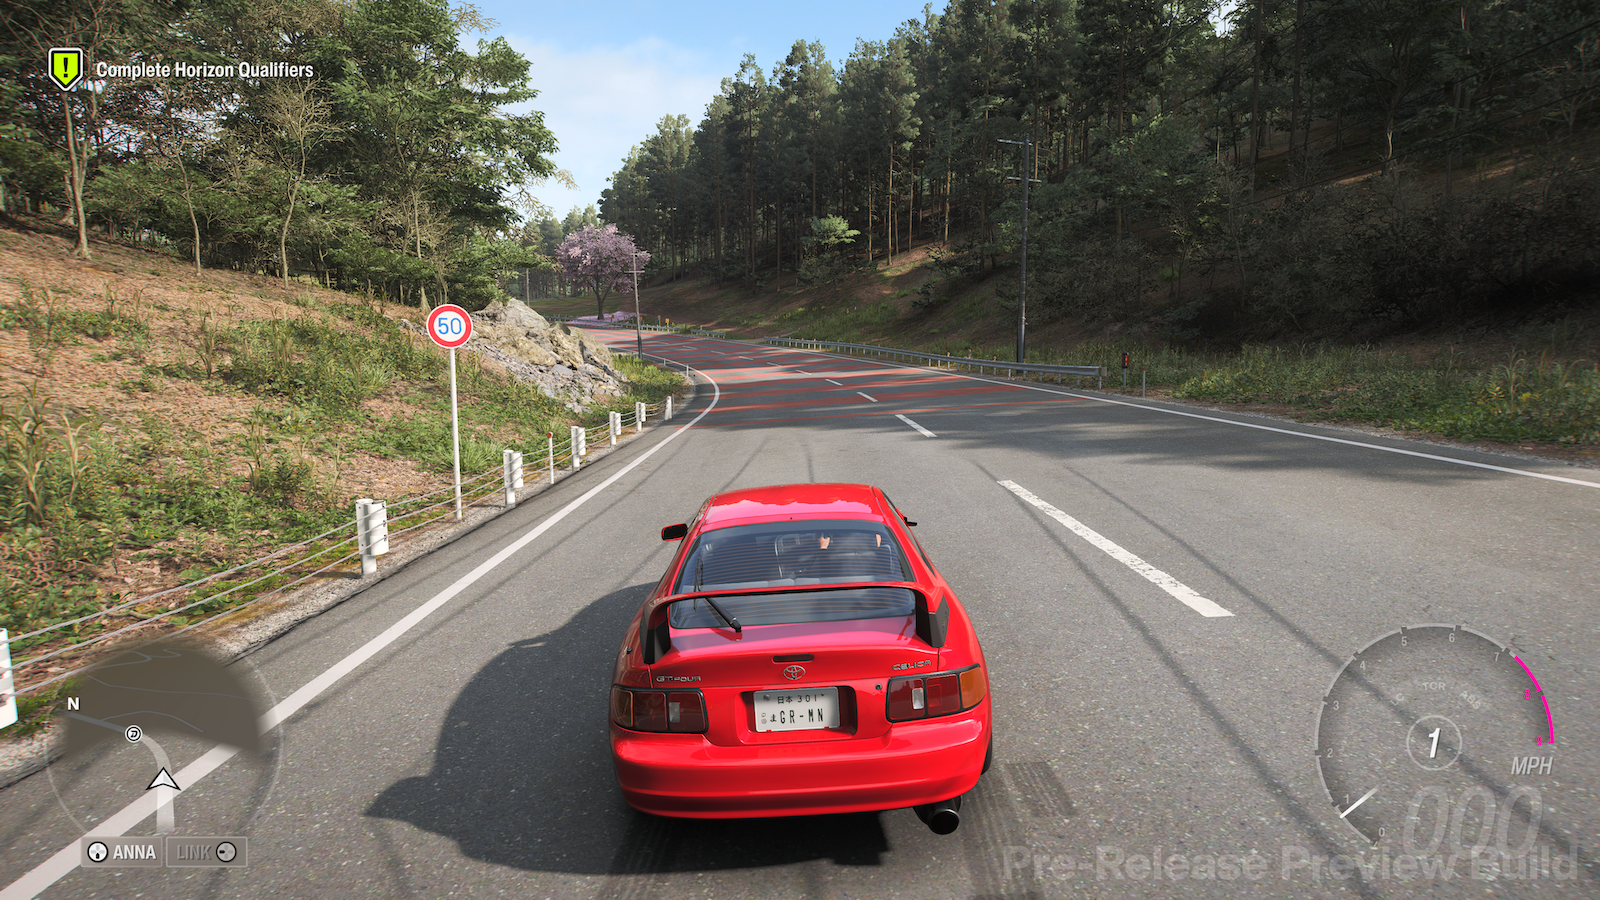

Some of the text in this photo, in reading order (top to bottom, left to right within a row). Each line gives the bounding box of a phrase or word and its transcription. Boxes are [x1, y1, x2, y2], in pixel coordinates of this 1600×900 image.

[438, 317, 462, 335] 50
[892, 659, 932, 671] CELICA
[777, 694, 818, 704] 日本 301
